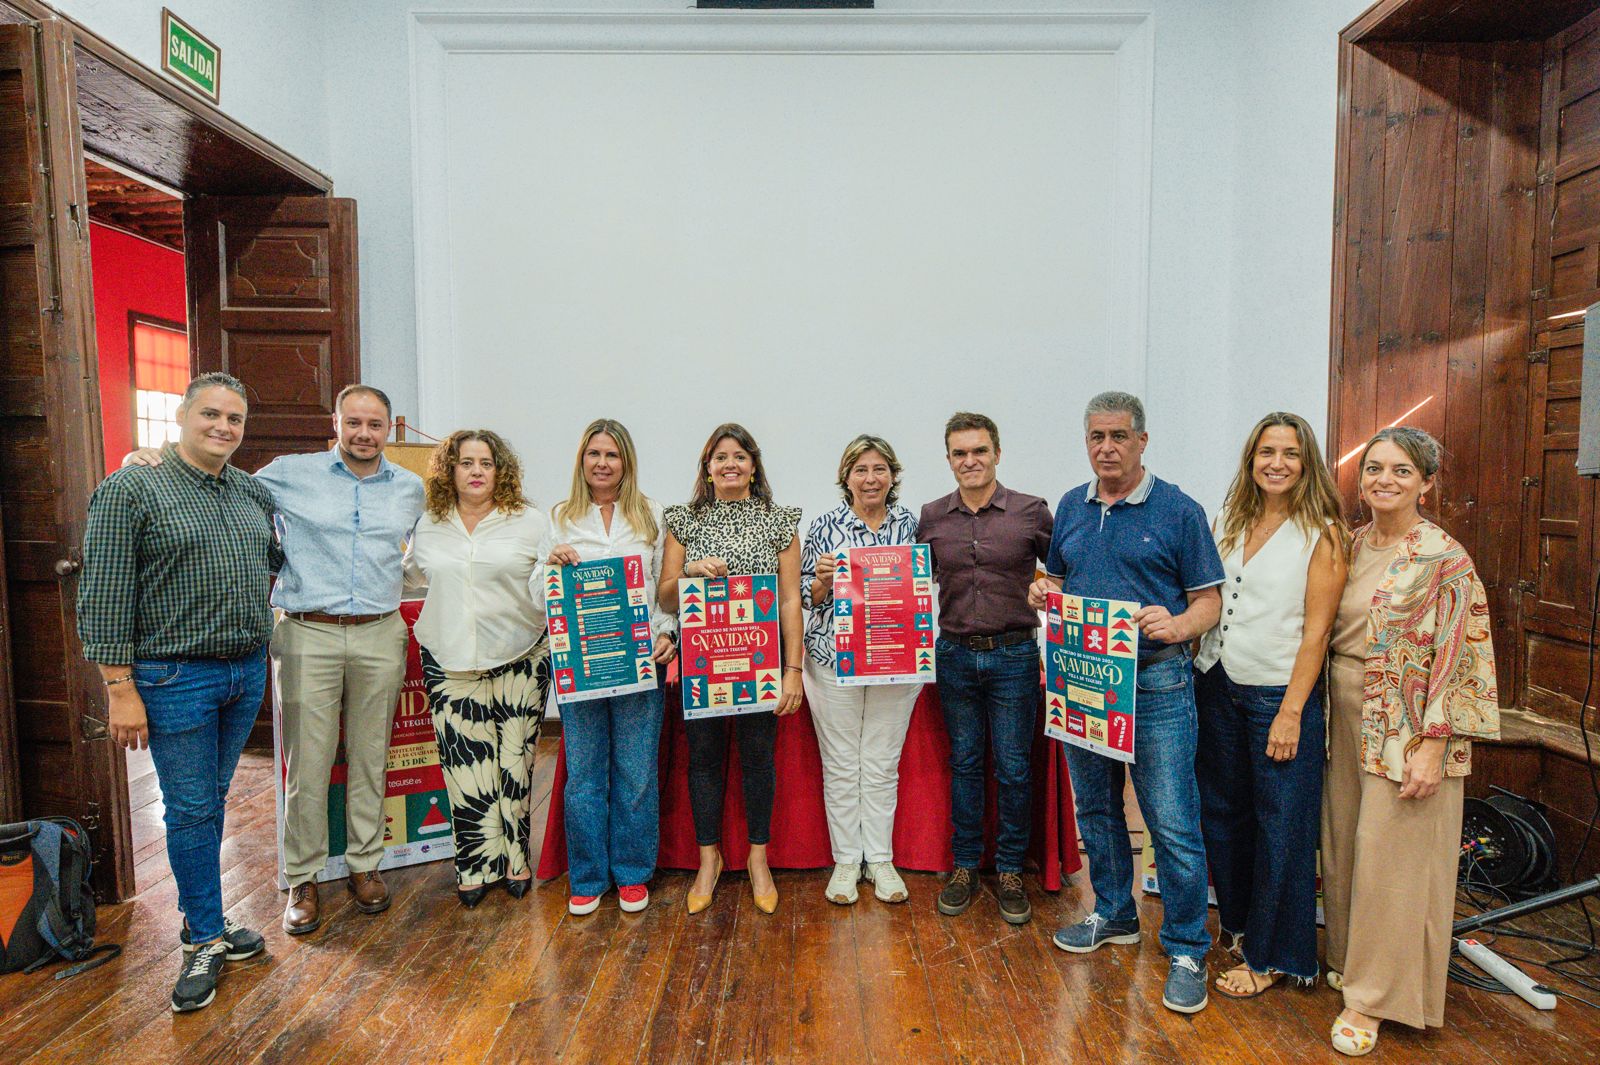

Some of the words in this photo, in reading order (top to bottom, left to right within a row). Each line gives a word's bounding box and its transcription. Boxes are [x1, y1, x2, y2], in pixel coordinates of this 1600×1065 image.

[171, 35, 213, 82] SALIDA
[572, 567, 614, 581] NAVIDAD
[691, 629, 768, 651] NAVIDAD
[1053, 651, 1123, 685] NAVIDAD
[403, 677, 426, 688] NAVI
[403, 718, 433, 728] TEGUI
[386, 761, 395, 769] 12
[412, 757, 427, 765] DIC
